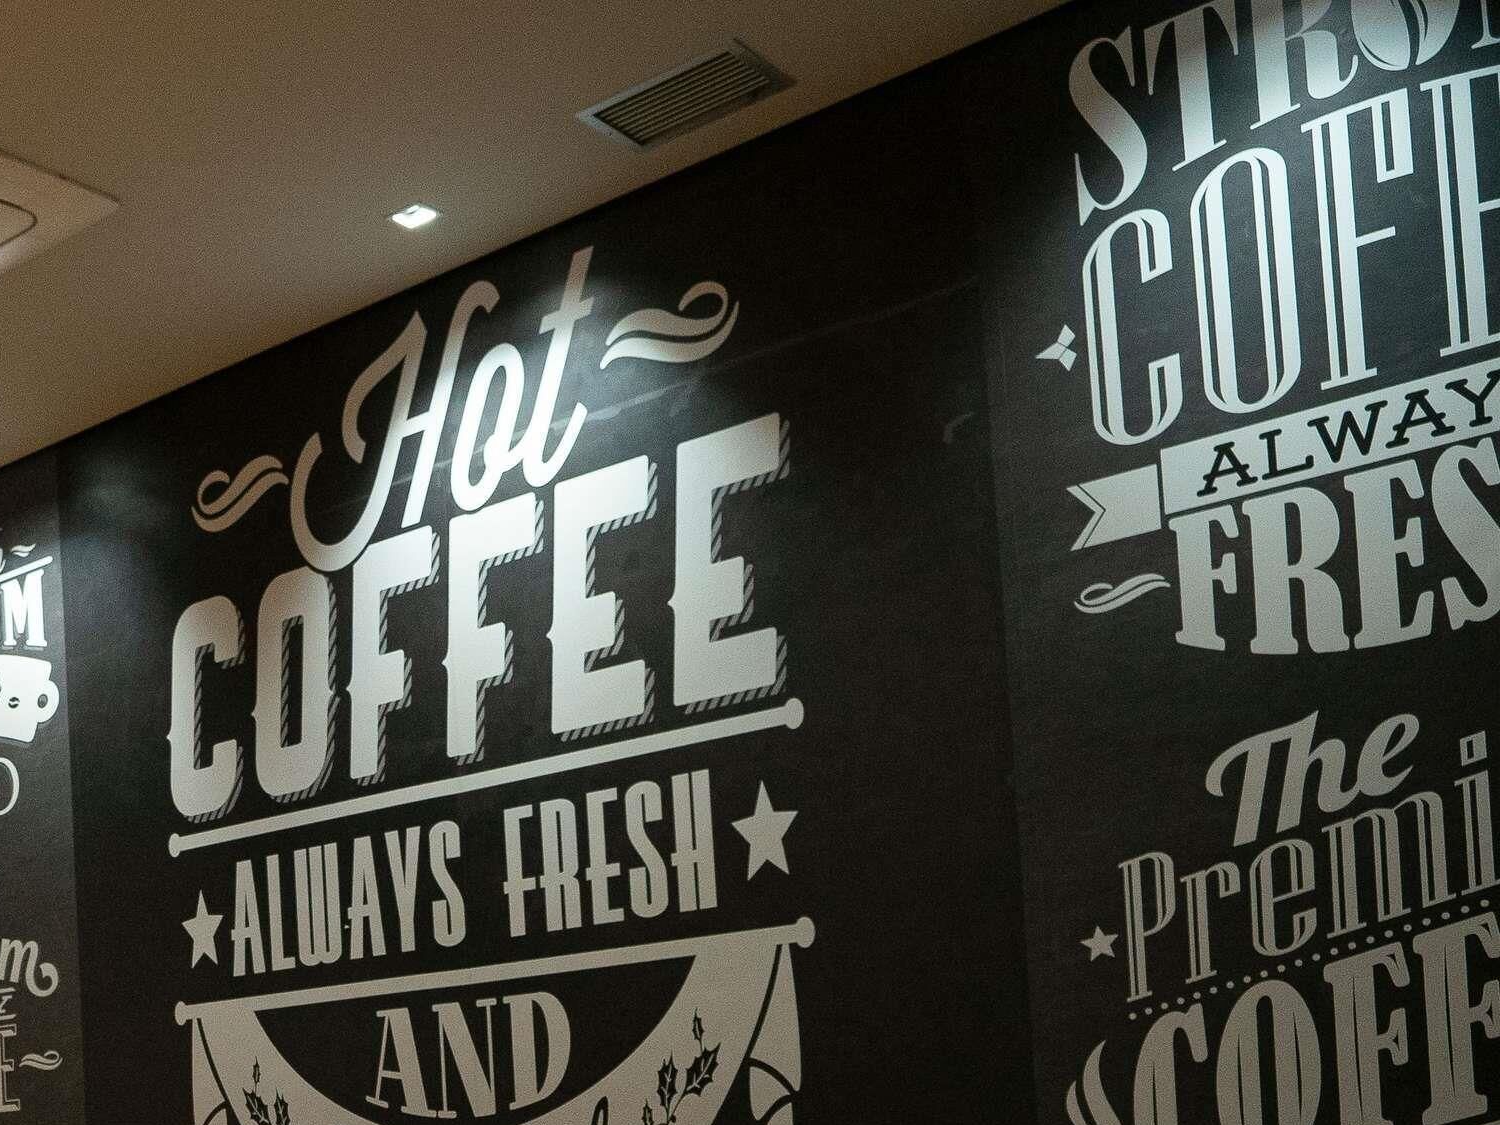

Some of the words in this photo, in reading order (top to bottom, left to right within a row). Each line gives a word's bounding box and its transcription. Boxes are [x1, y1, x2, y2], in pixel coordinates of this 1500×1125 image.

[290, 246, 594, 571] Hot
[167, 411, 790, 821] COFFEE
[1168, 437, 1500, 655] FRES
[231, 820, 466, 976] ALWAYS
[504, 769, 717, 937] FRESH
[1118, 731, 1500, 1002] Premi
[1205, 711, 1420, 847] The
[366, 992, 570, 1119] AND
